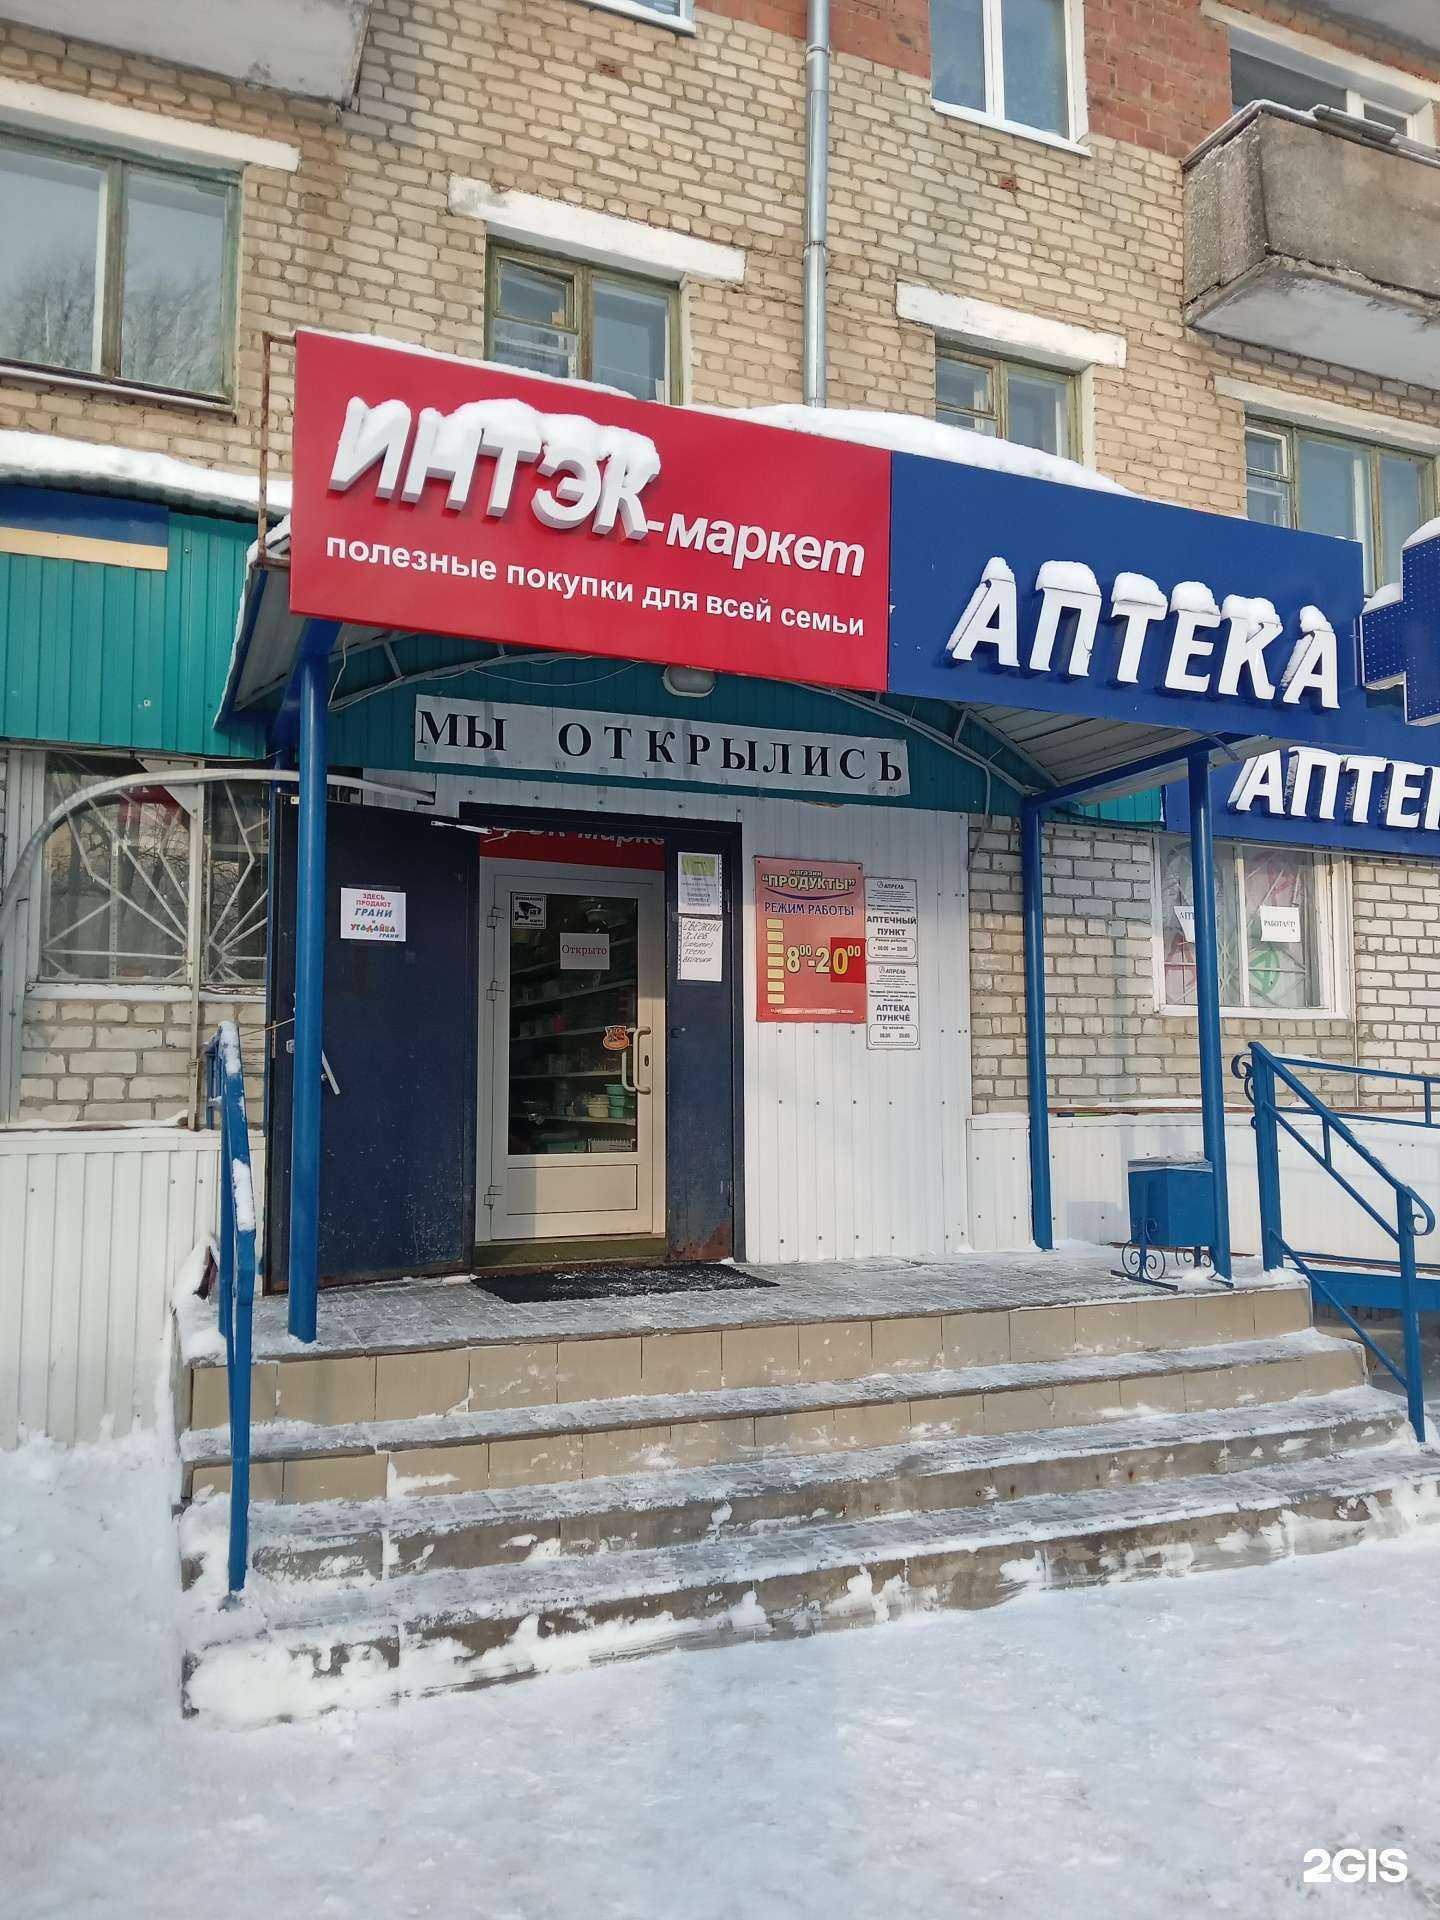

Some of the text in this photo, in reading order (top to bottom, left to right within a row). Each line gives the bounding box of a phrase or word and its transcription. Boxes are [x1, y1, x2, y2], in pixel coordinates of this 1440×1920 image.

[326, 536, 864, 636] полезные покупки для всей семьи
[946, 572, 1340, 709] АПТЕКА
[417, 709, 902, 783] МЫ ОТКРЫЛИСЬ
[355, 899, 392, 907] ПРОДАЮТ
[354, 908, 393, 918] ГРАНИ
[764, 902, 805, 914] РЕЖИМ
[808, 905, 855, 916] РАБОТЫ
[866, 915, 917, 925] АПТЕЧНЫЙ
[877, 928, 906, 936] ПУНКТ
[561, 944, 608, 957] Открыто
[876, 1004, 911, 1012] АПТЕКА
